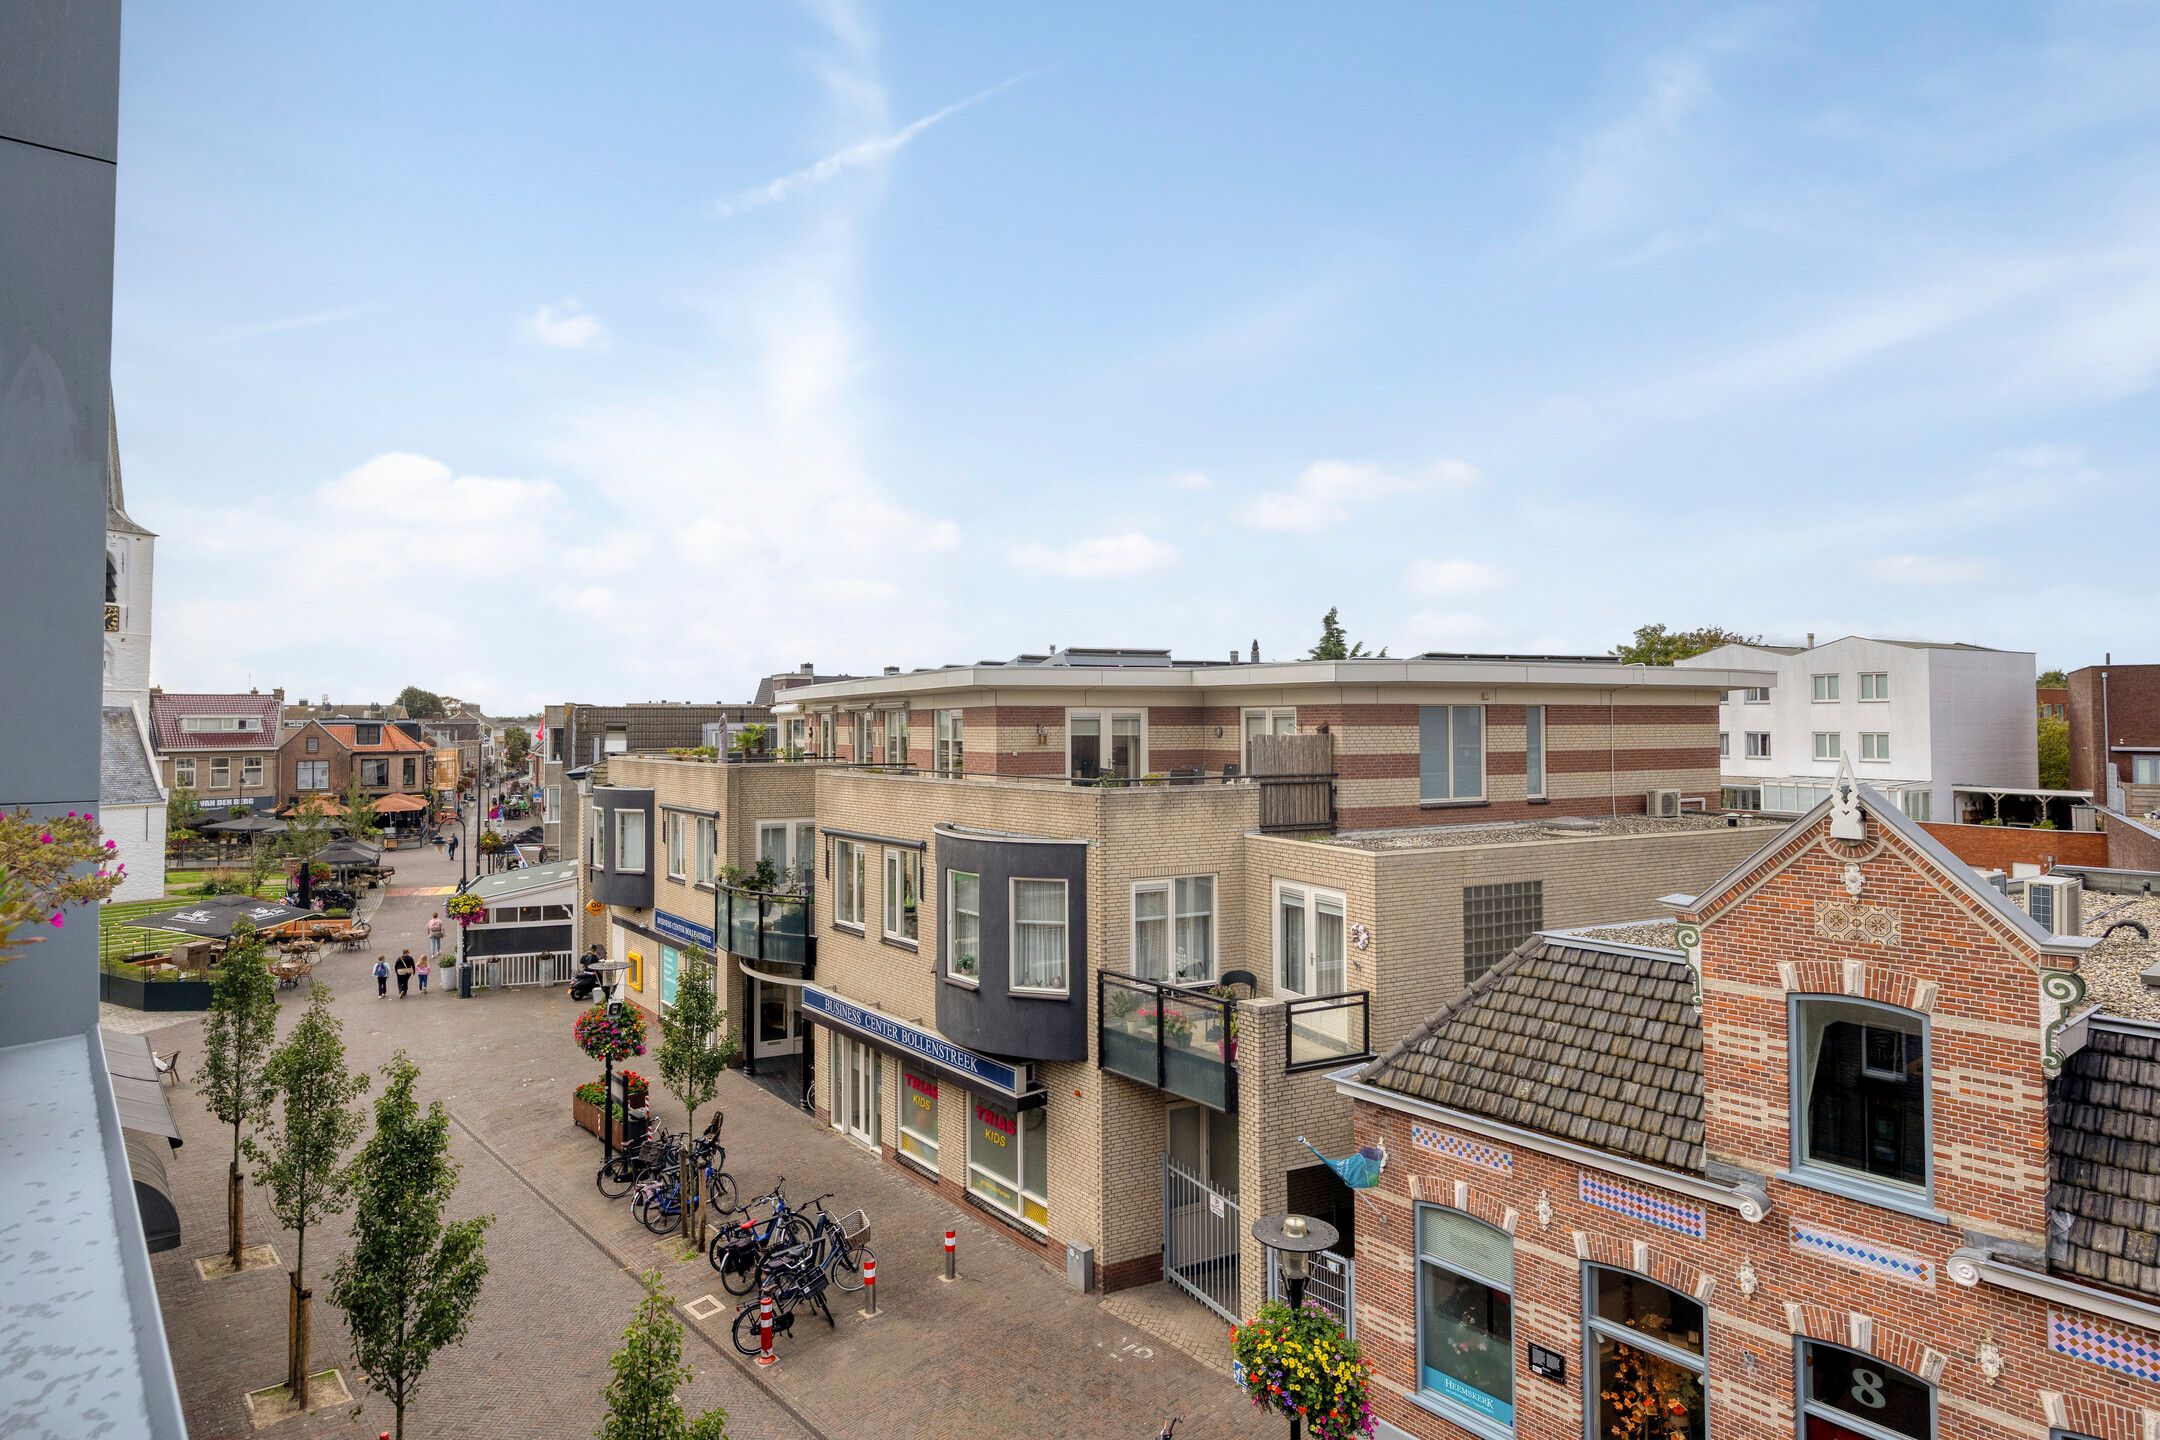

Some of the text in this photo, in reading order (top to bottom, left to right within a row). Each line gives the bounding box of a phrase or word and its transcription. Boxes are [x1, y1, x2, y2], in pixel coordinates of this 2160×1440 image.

[199, 799, 216, 807] VAN
[824, 998, 979, 1074] BUSINESS CENTER BOLLENSTREEK
[912, 1094, 931, 1111] KIDS
[975, 1104, 1016, 1136] TRIAS
[985, 1128, 1007, 1147] KIDS
[1444, 1378, 1494, 1409] HEEMSKERK
[1851, 1368, 1886, 1409] 8
